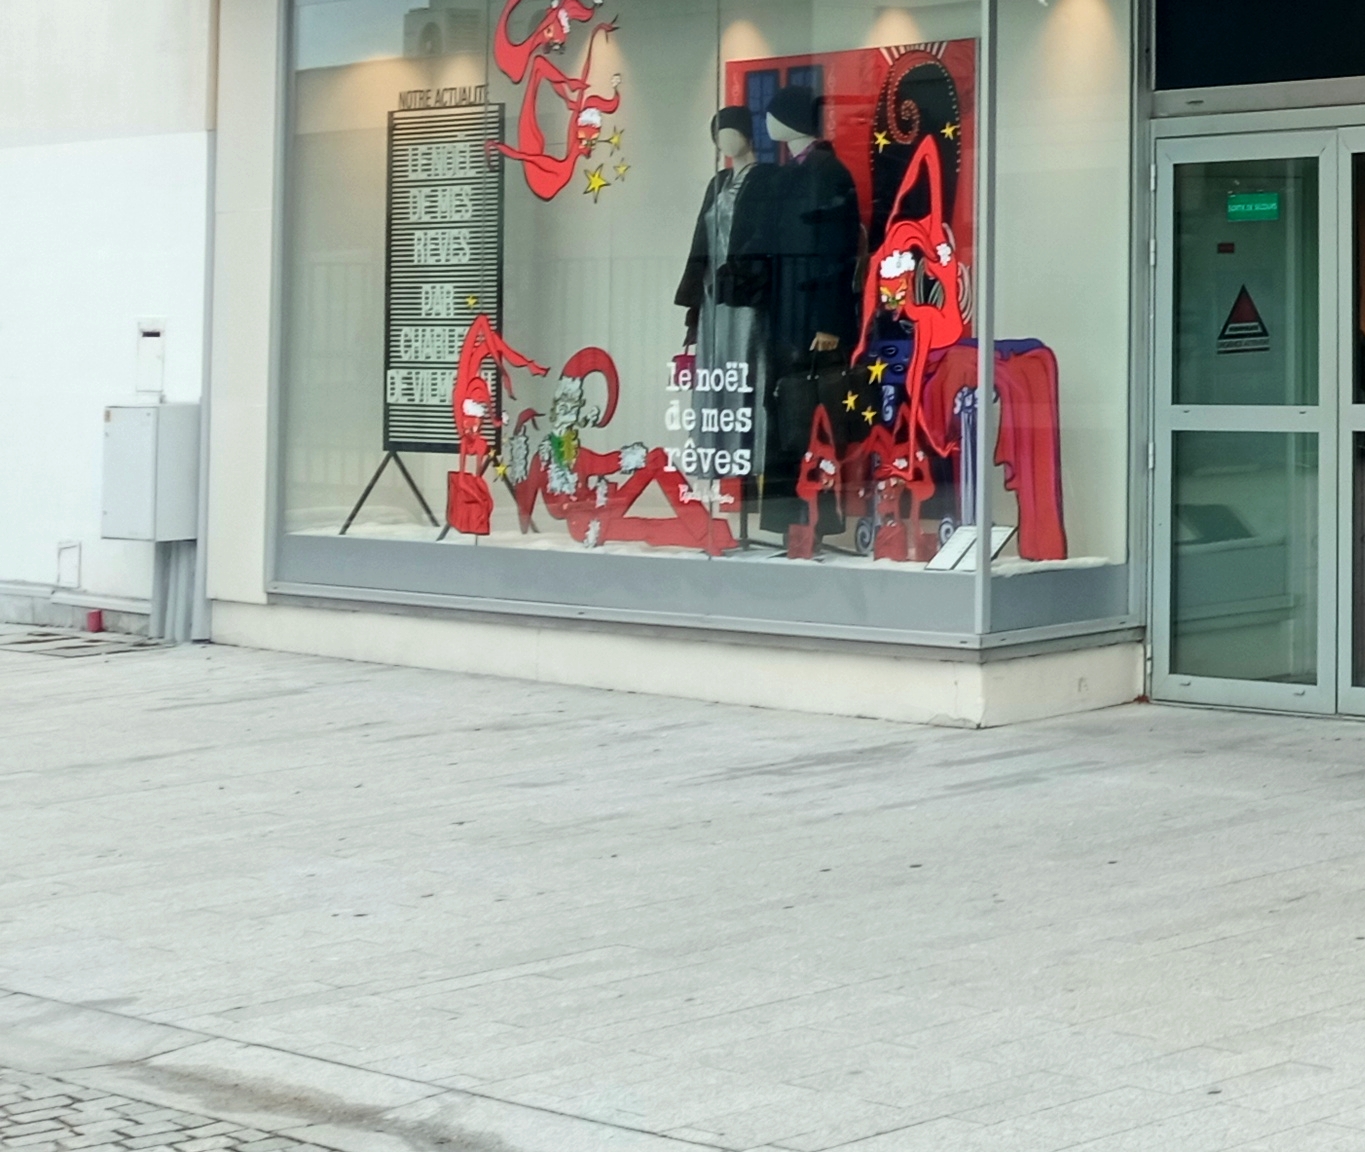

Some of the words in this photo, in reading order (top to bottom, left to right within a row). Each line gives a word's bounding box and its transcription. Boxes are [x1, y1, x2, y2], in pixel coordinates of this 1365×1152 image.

[398, 89, 431, 109] NOTRE
[421, 285, 455, 317] PAR
[665, 362, 692, 391] le
[695, 361, 754, 393] noël
[665, 400, 696, 431] de
[702, 407, 753, 433] mes
[664, 438, 751, 476] rêves
